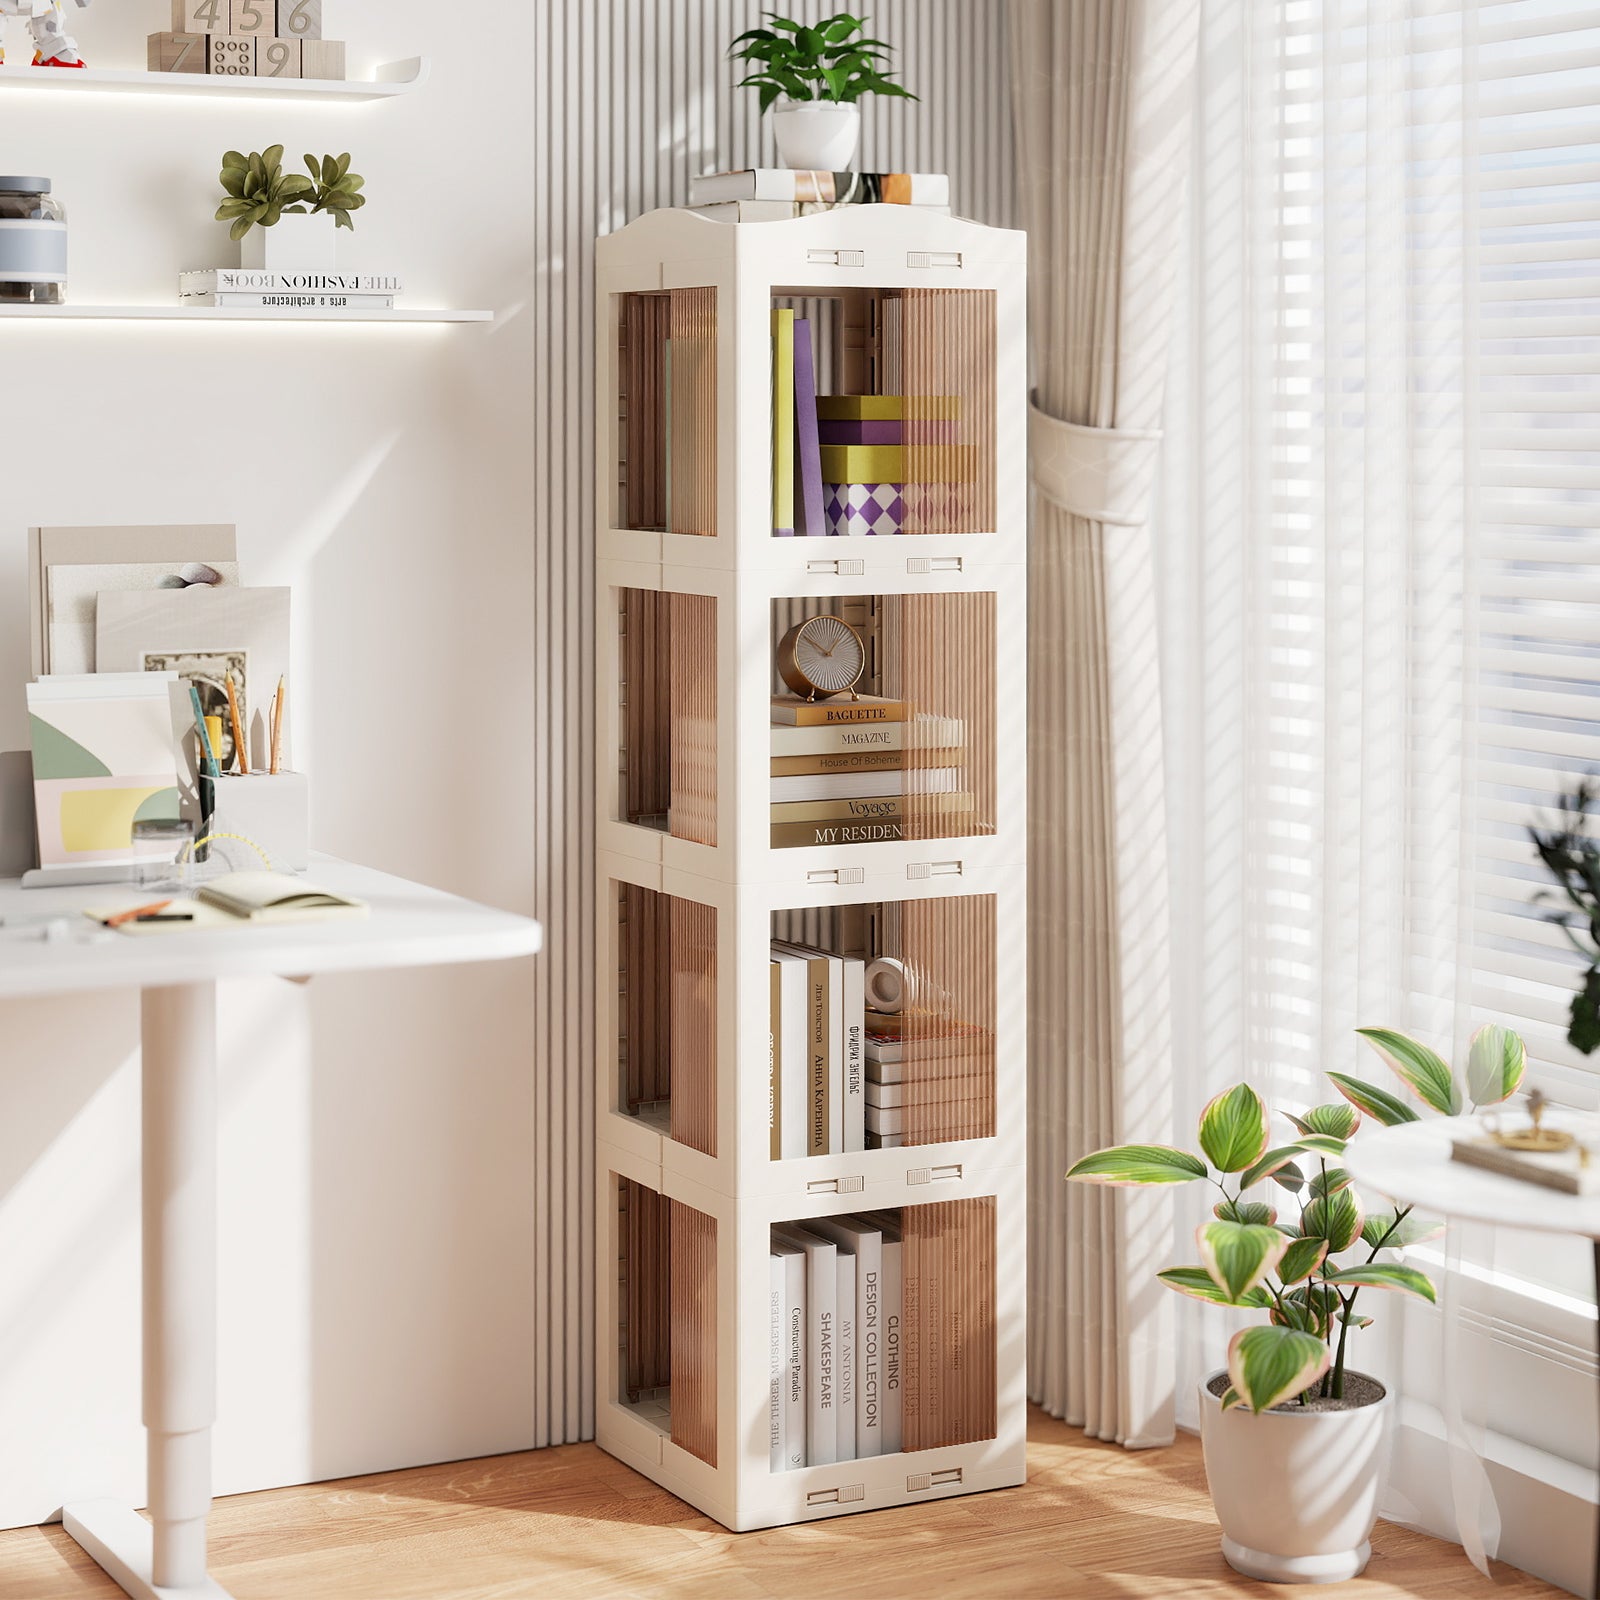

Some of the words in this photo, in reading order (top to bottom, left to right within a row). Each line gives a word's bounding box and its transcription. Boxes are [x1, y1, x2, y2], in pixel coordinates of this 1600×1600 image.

[193, 0, 221, 29] 4
[239, 0, 265, 31] 5
[288, 0, 313, 34] 6
[169, 37, 198, 72] 7
[266, 42, 290, 77] 9
[281, 275, 360, 289] FASHION
[363, 276, 402, 290] THE
[262, 296, 316, 308] architecture
[329, 297, 347, 307] arts
[827, 708, 886, 721] BAGUETTE
[842, 731, 891, 745] MAGAZINE
[820, 759, 848, 768] House
[850, 756, 862, 766] Of
[864, 755, 901, 765] Boheme
[848, 801, 897, 817] Voyage
[815, 827, 838, 844] MY
[842, 822, 920, 842] RESIDEN
[866, 1272, 877, 1328] DESIGN
[770, 1291, 779, 1375] MUSKETEERS
[790, 1307, 802, 1363] Constructing
[843, 1320, 851, 1340] MY
[821, 1312, 832, 1409] SHAKESPEARE
[888, 1315, 899, 1390] CLOTHING
[792, 1365, 802, 1402] Paradies
[843, 1343, 851, 1404] ANTONIA
[866, 1331, 877, 1428] COLLECTION
[770, 1378, 779, 1420] THREE
[770, 1422, 779, 1448] THE
